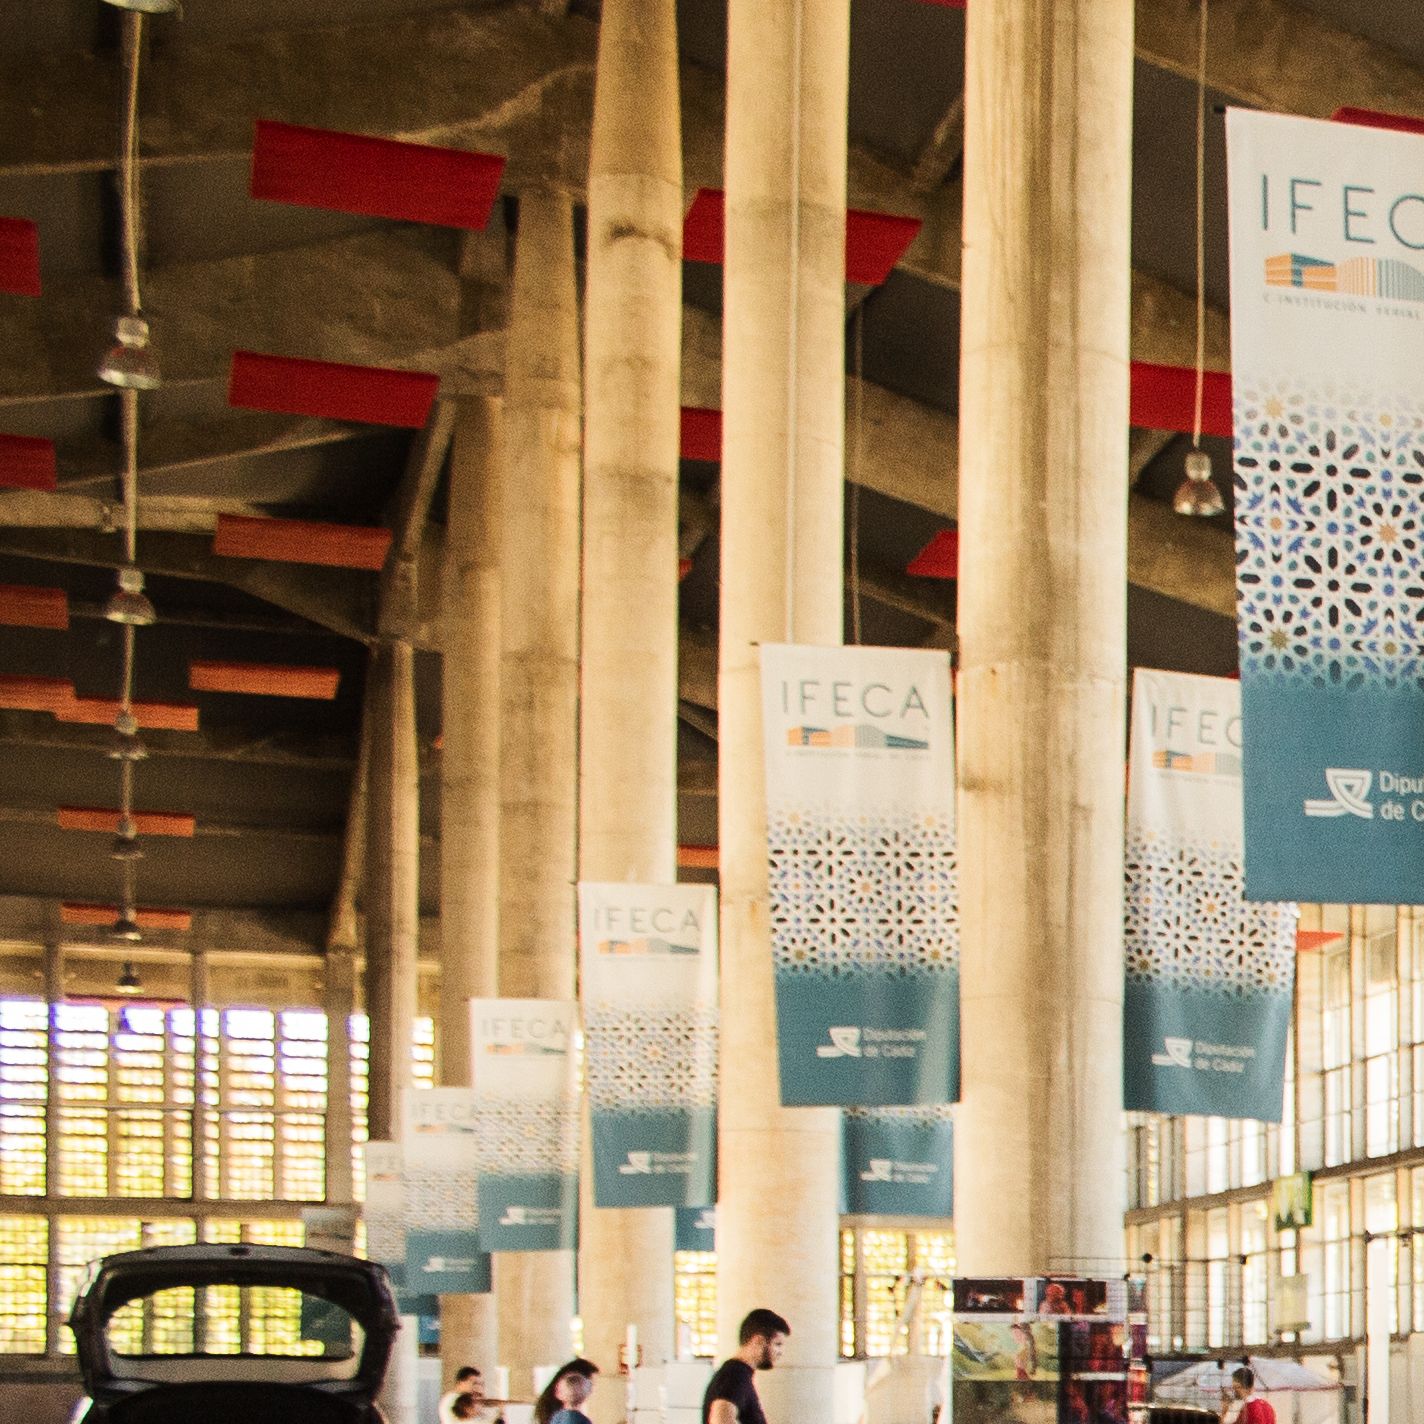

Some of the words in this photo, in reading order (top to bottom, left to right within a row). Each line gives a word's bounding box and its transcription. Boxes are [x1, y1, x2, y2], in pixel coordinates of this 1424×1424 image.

[782, 680, 930, 719] IFECA
[1380, 801, 1405, 821] de
[594, 907, 701, 934] IFECA
[482, 1017, 566, 1039] IFECA
